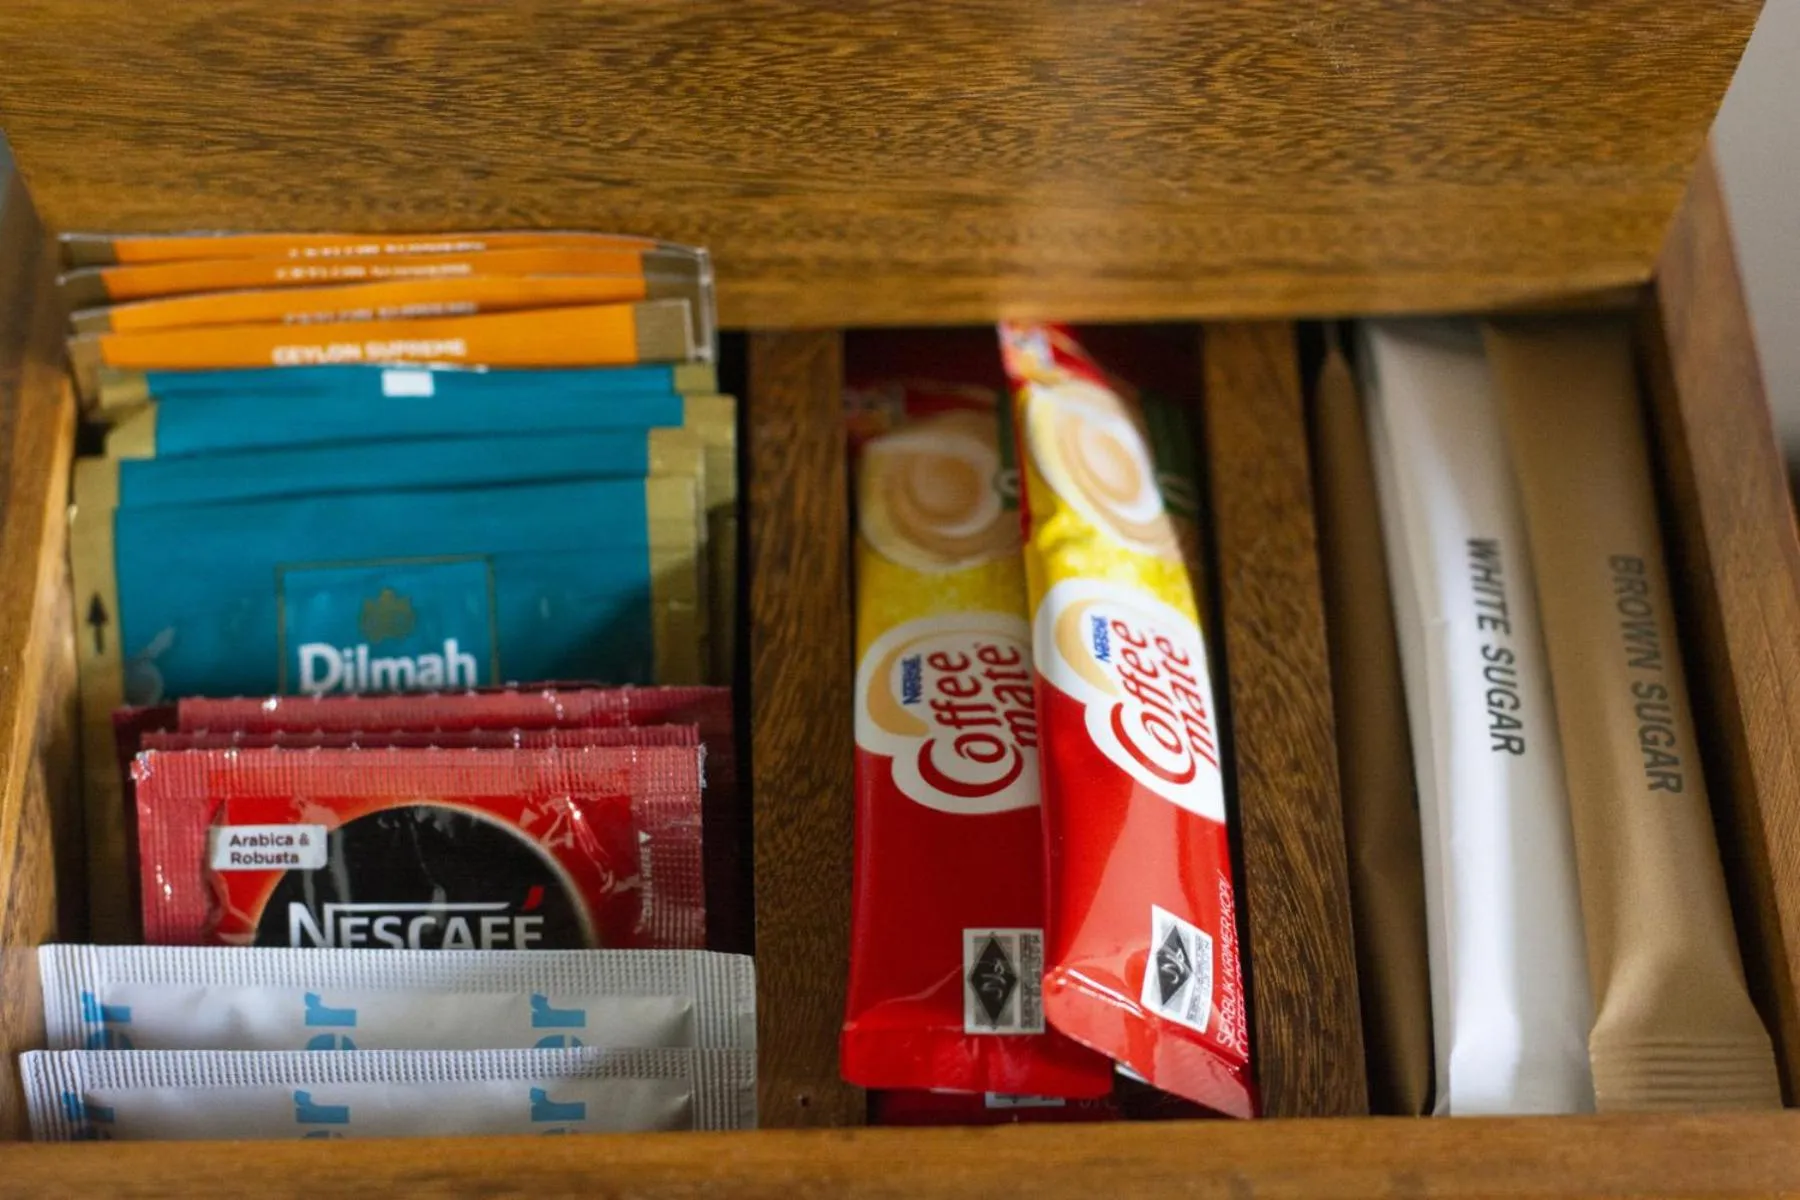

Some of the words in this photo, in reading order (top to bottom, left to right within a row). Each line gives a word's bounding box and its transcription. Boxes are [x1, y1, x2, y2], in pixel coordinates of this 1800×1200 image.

[1466, 538, 1511, 635] WHITE
[1608, 554, 1663, 672] BROWN
[298, 637, 478, 694] Dilmah
[1109, 619, 1197, 785] Coffee
[1481, 645, 1526, 757] SUGAR
[917, 651, 1024, 798] Coffee
[1630, 680, 1684, 794] SUGAR
[229, 833, 294, 848] Arabica
[230, 851, 300, 866] Robusta
